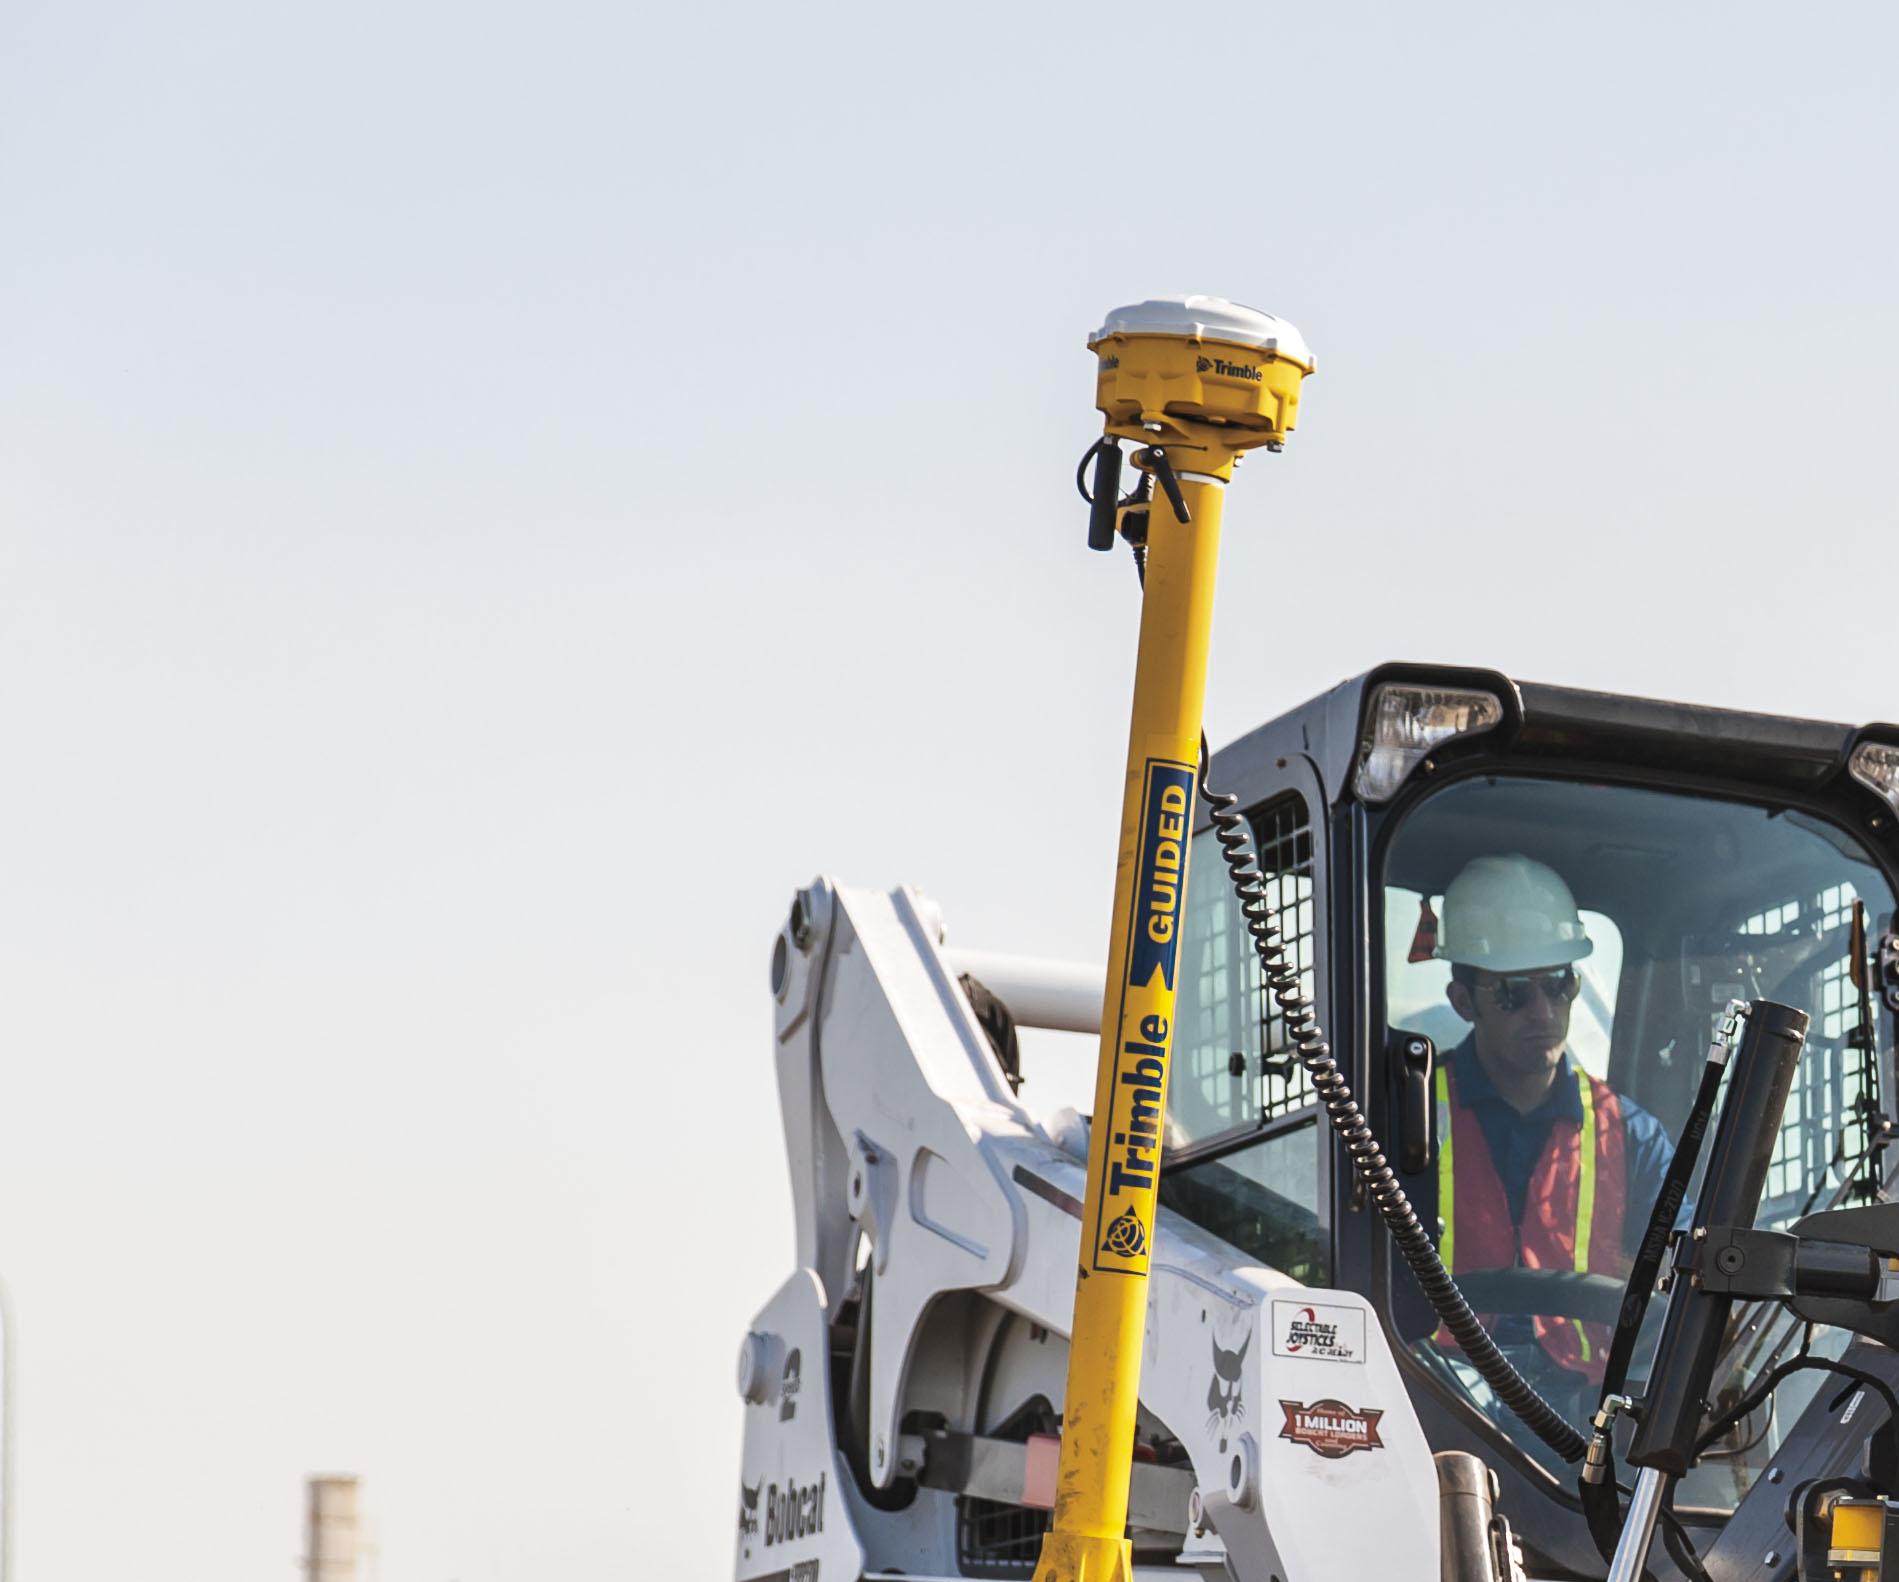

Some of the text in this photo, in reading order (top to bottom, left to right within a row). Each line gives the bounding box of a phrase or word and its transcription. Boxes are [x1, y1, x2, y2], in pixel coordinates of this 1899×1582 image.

[1213, 358, 1263, 381] Trimble
[1148, 784, 1187, 944] GUIDED
[1109, 1013, 1169, 1196] Trimble
[1295, 1414, 1368, 1434] 1 MILLION
[764, 1470, 826, 1548] Bobcat
